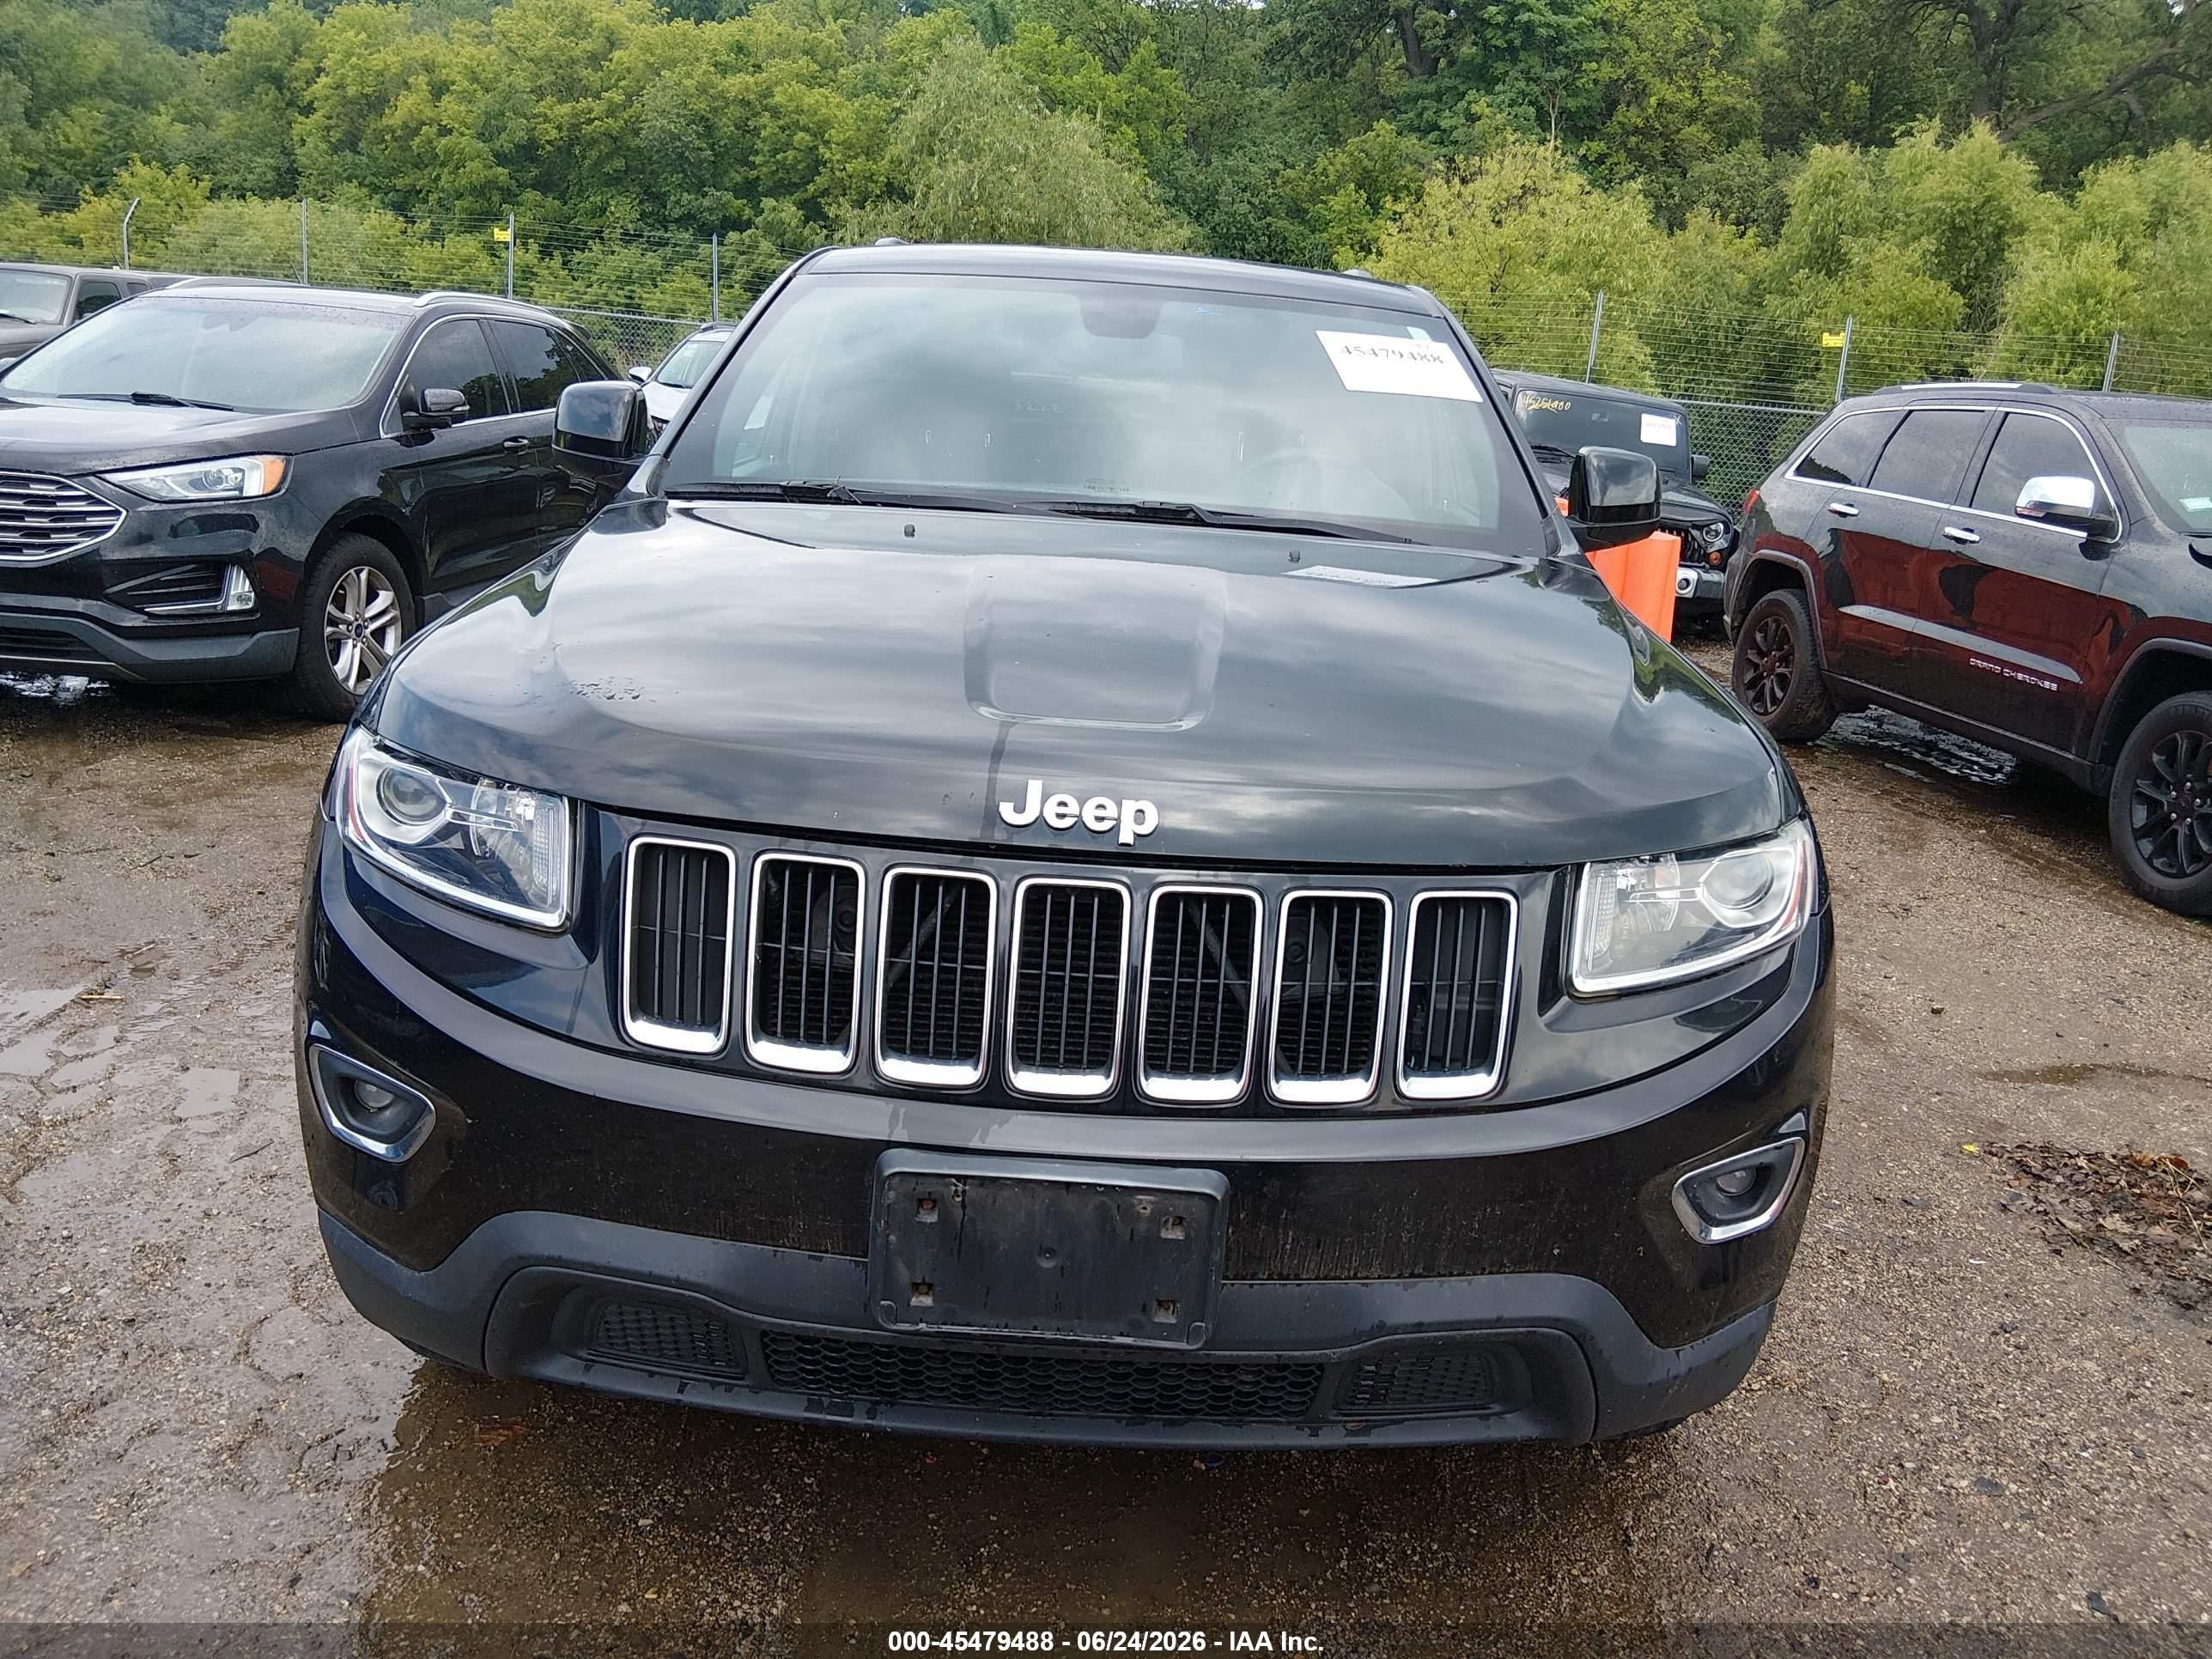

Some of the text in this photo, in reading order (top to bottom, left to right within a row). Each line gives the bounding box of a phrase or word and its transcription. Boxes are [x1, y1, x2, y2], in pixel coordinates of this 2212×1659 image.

[1340, 345, 1443, 364] 45479488
[1969, 658, 2058, 691] GRAND CHEROKEE
[998, 779, 1159, 846] Jeep
